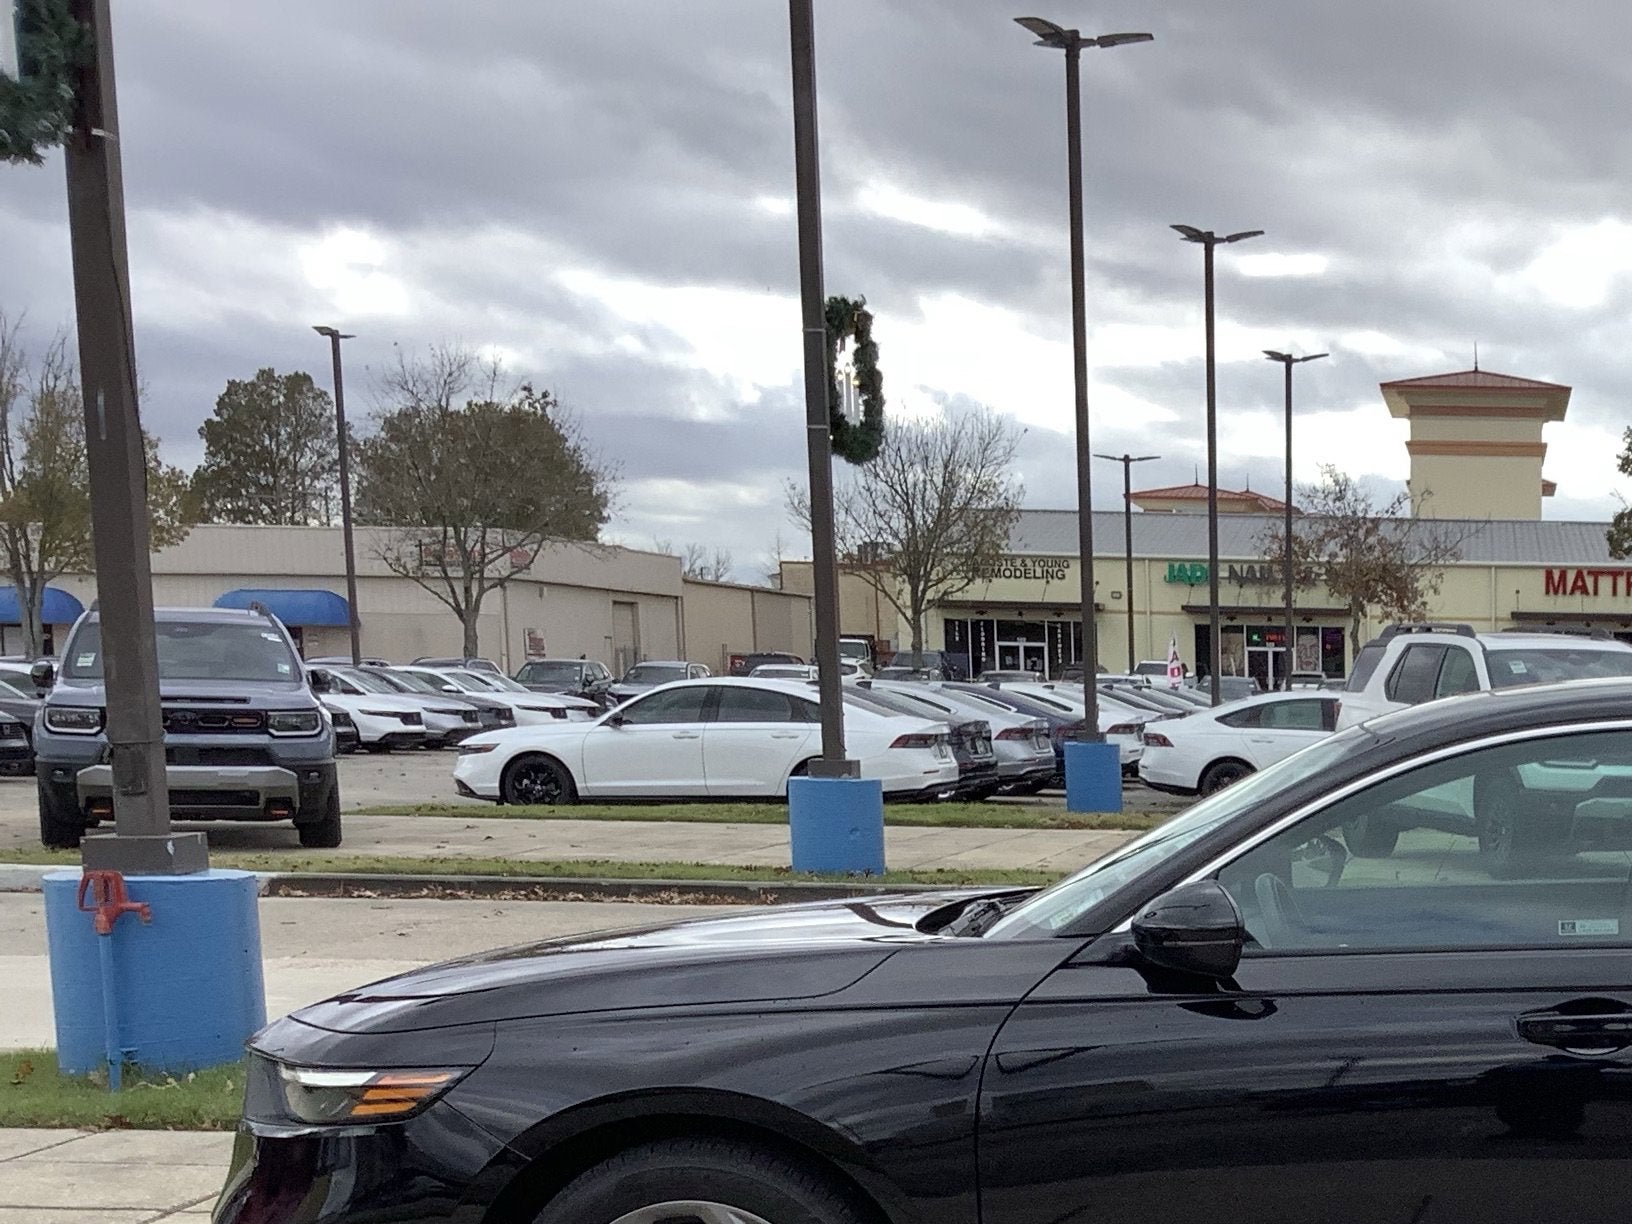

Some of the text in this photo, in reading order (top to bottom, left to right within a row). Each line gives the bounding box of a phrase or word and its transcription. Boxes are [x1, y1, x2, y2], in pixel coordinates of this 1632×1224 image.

[1019, 559, 1029, 568] &
[1031, 559, 1070, 569] YOUNG
[974, 568, 1066, 580] REMODELING
